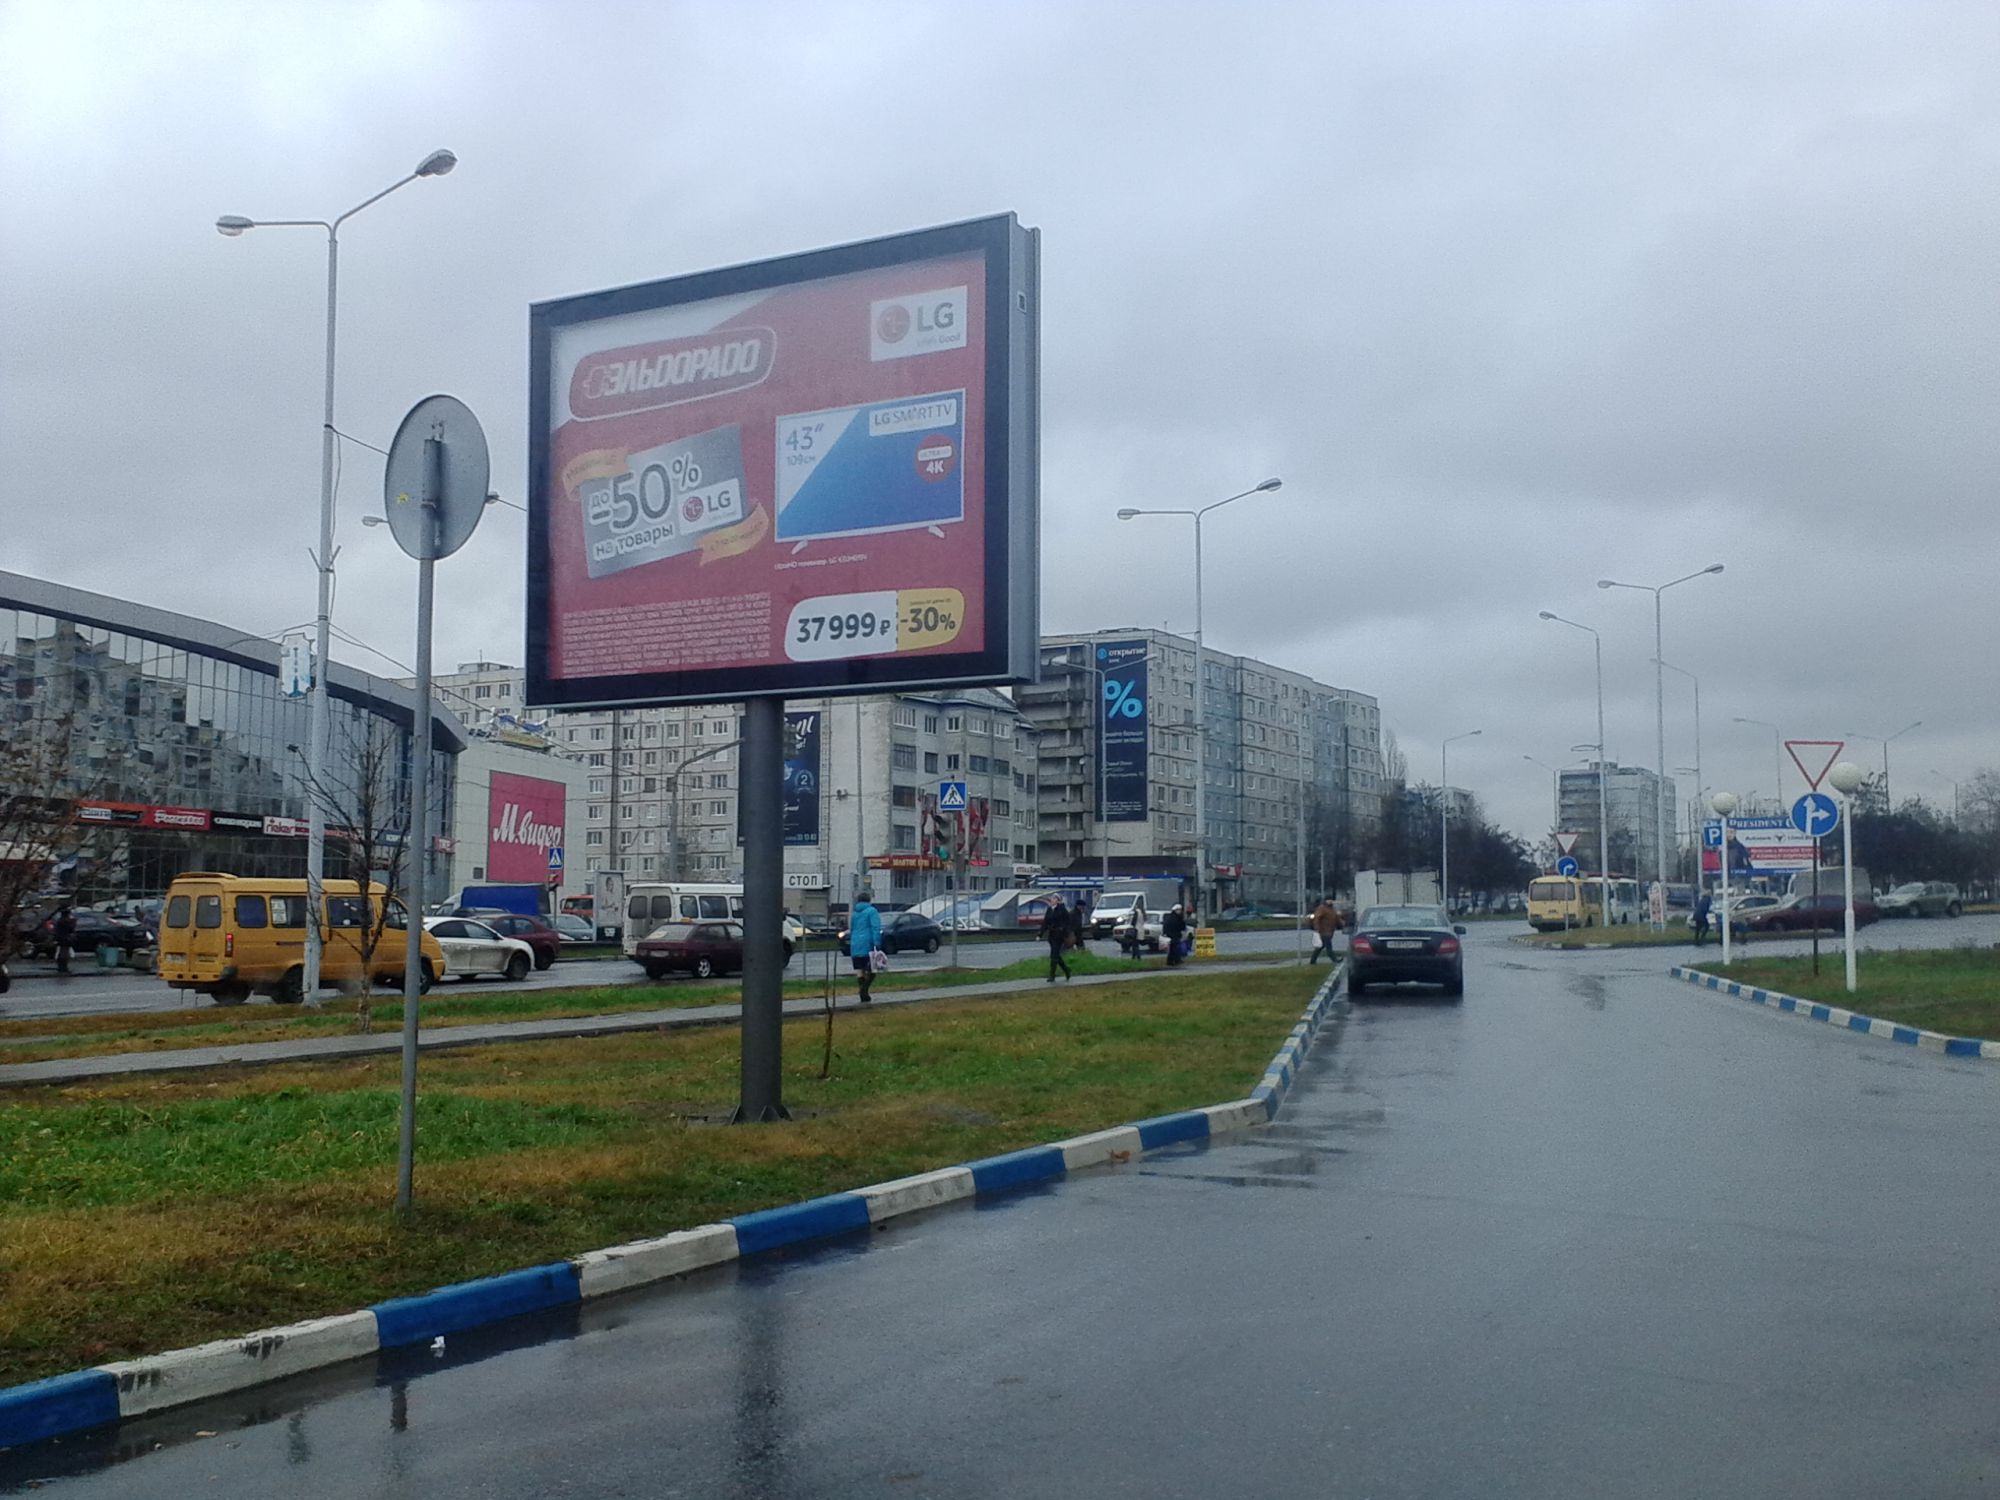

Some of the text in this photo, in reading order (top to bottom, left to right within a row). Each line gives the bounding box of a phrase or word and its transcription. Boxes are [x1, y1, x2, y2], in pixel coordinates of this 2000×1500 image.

[917, 302, 954, 332] LG
[874, 412, 891, 426] LG
[937, 403, 952, 417] TV
[926, 460, 944, 474] 4K
[707, 490, 732, 513] LG
[616, 524, 674, 551] товары
[900, 606, 956, 633] -30%
[265, 821, 295, 835] rieker
[492, 803, 562, 856] М.видео
[788, 874, 818, 887] СТОП
